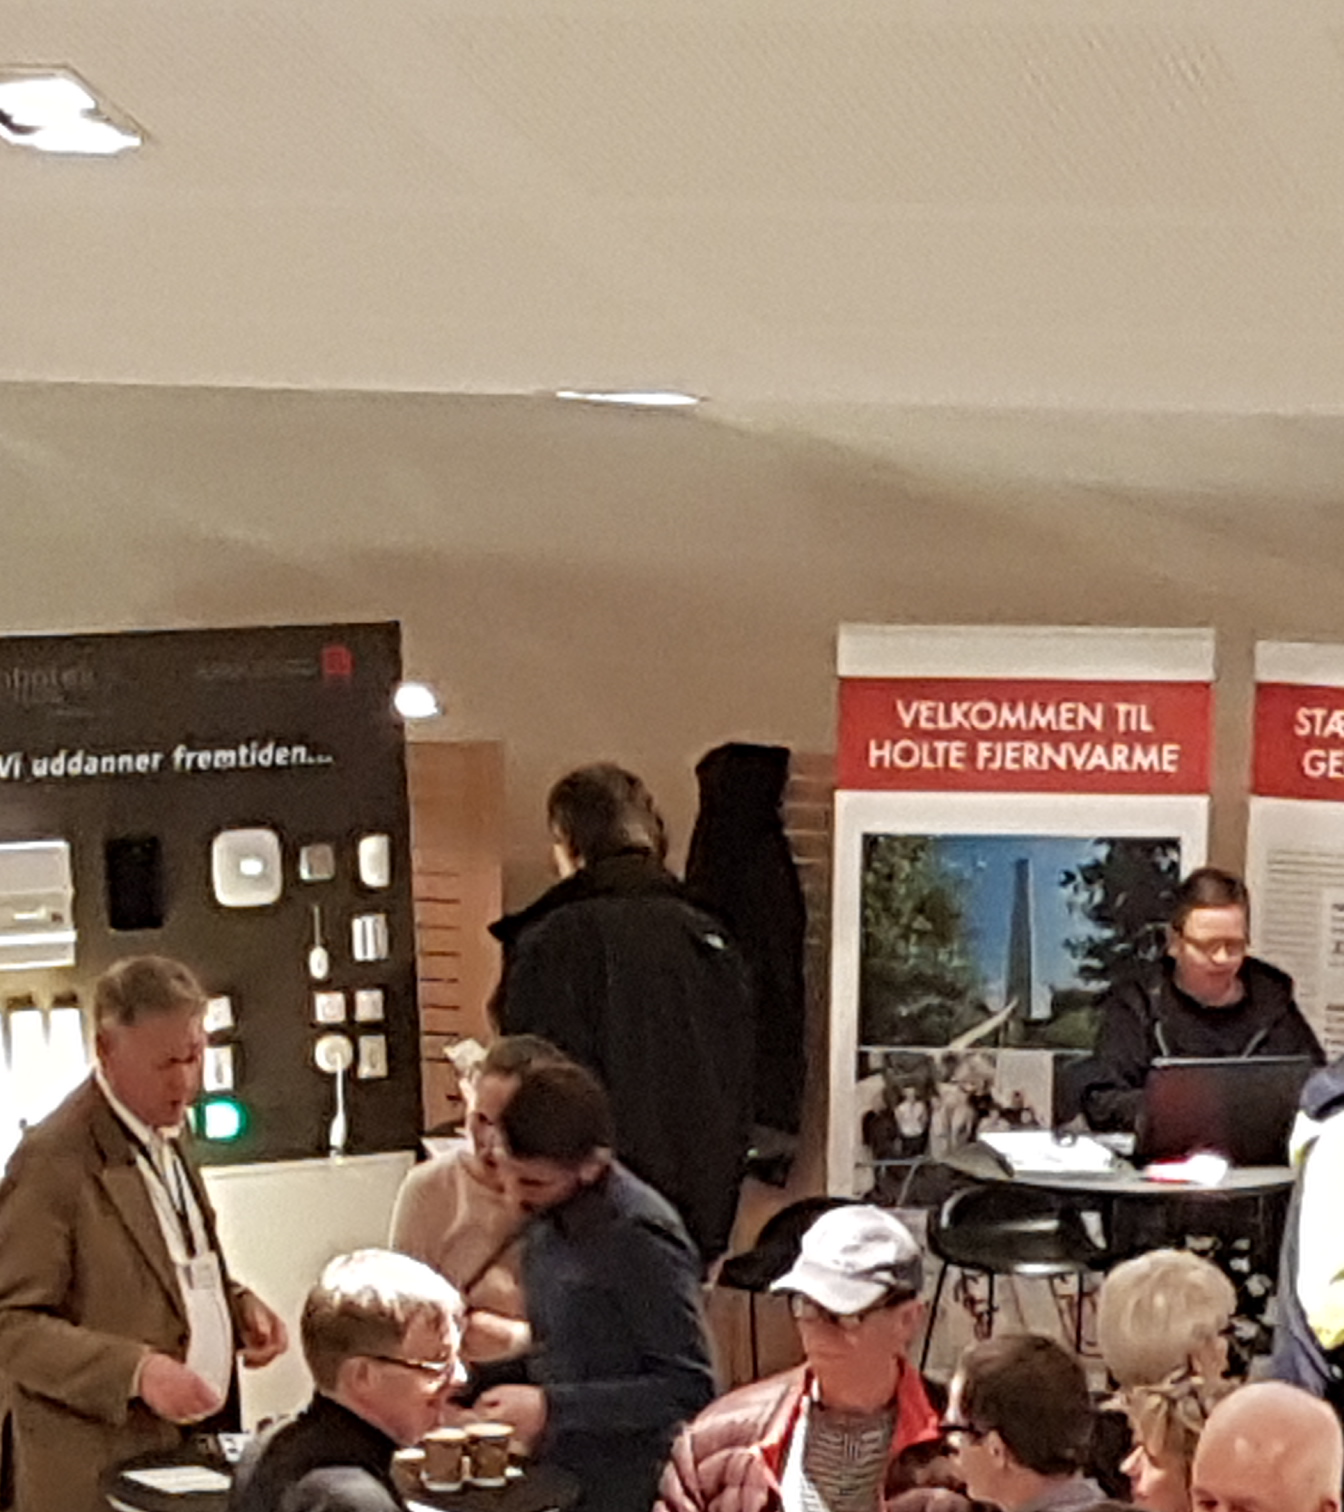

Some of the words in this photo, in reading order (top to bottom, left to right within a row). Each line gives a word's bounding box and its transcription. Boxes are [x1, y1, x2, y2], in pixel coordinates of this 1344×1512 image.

[897, 700, 1103, 731] VELKOMMEN
[1114, 702, 1154, 733] TIL
[31, 749, 162, 778] uddanner
[868, 739, 967, 770] HOLTE
[977, 742, 1181, 773] FJERNVARME
